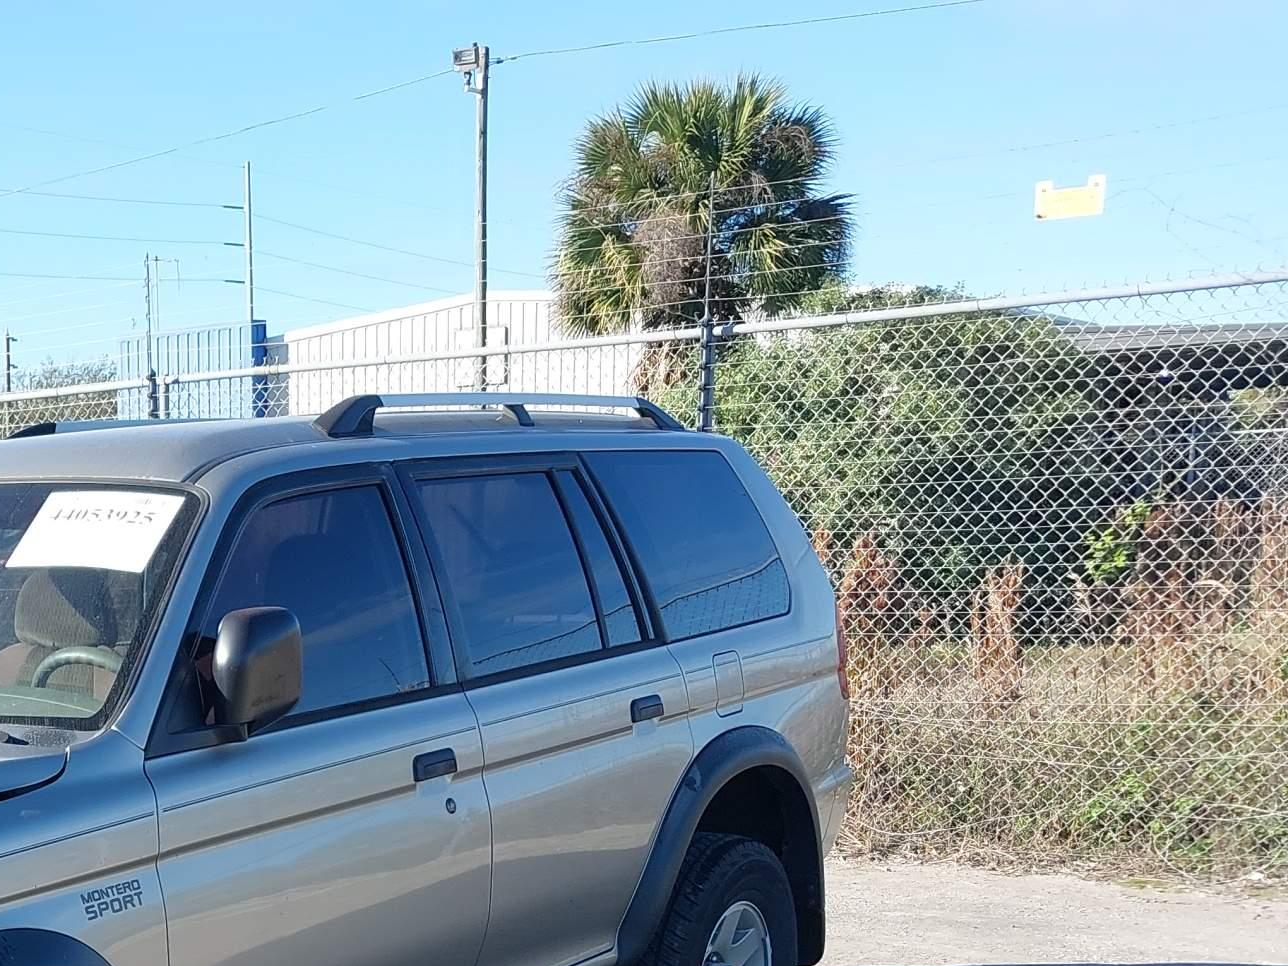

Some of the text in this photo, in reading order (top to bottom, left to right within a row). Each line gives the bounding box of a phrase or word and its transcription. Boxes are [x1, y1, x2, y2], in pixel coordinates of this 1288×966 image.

[50, 508, 158, 525] 44053925
[80, 879, 142, 905] MONTERO
[84, 891, 143, 921] SPORT
